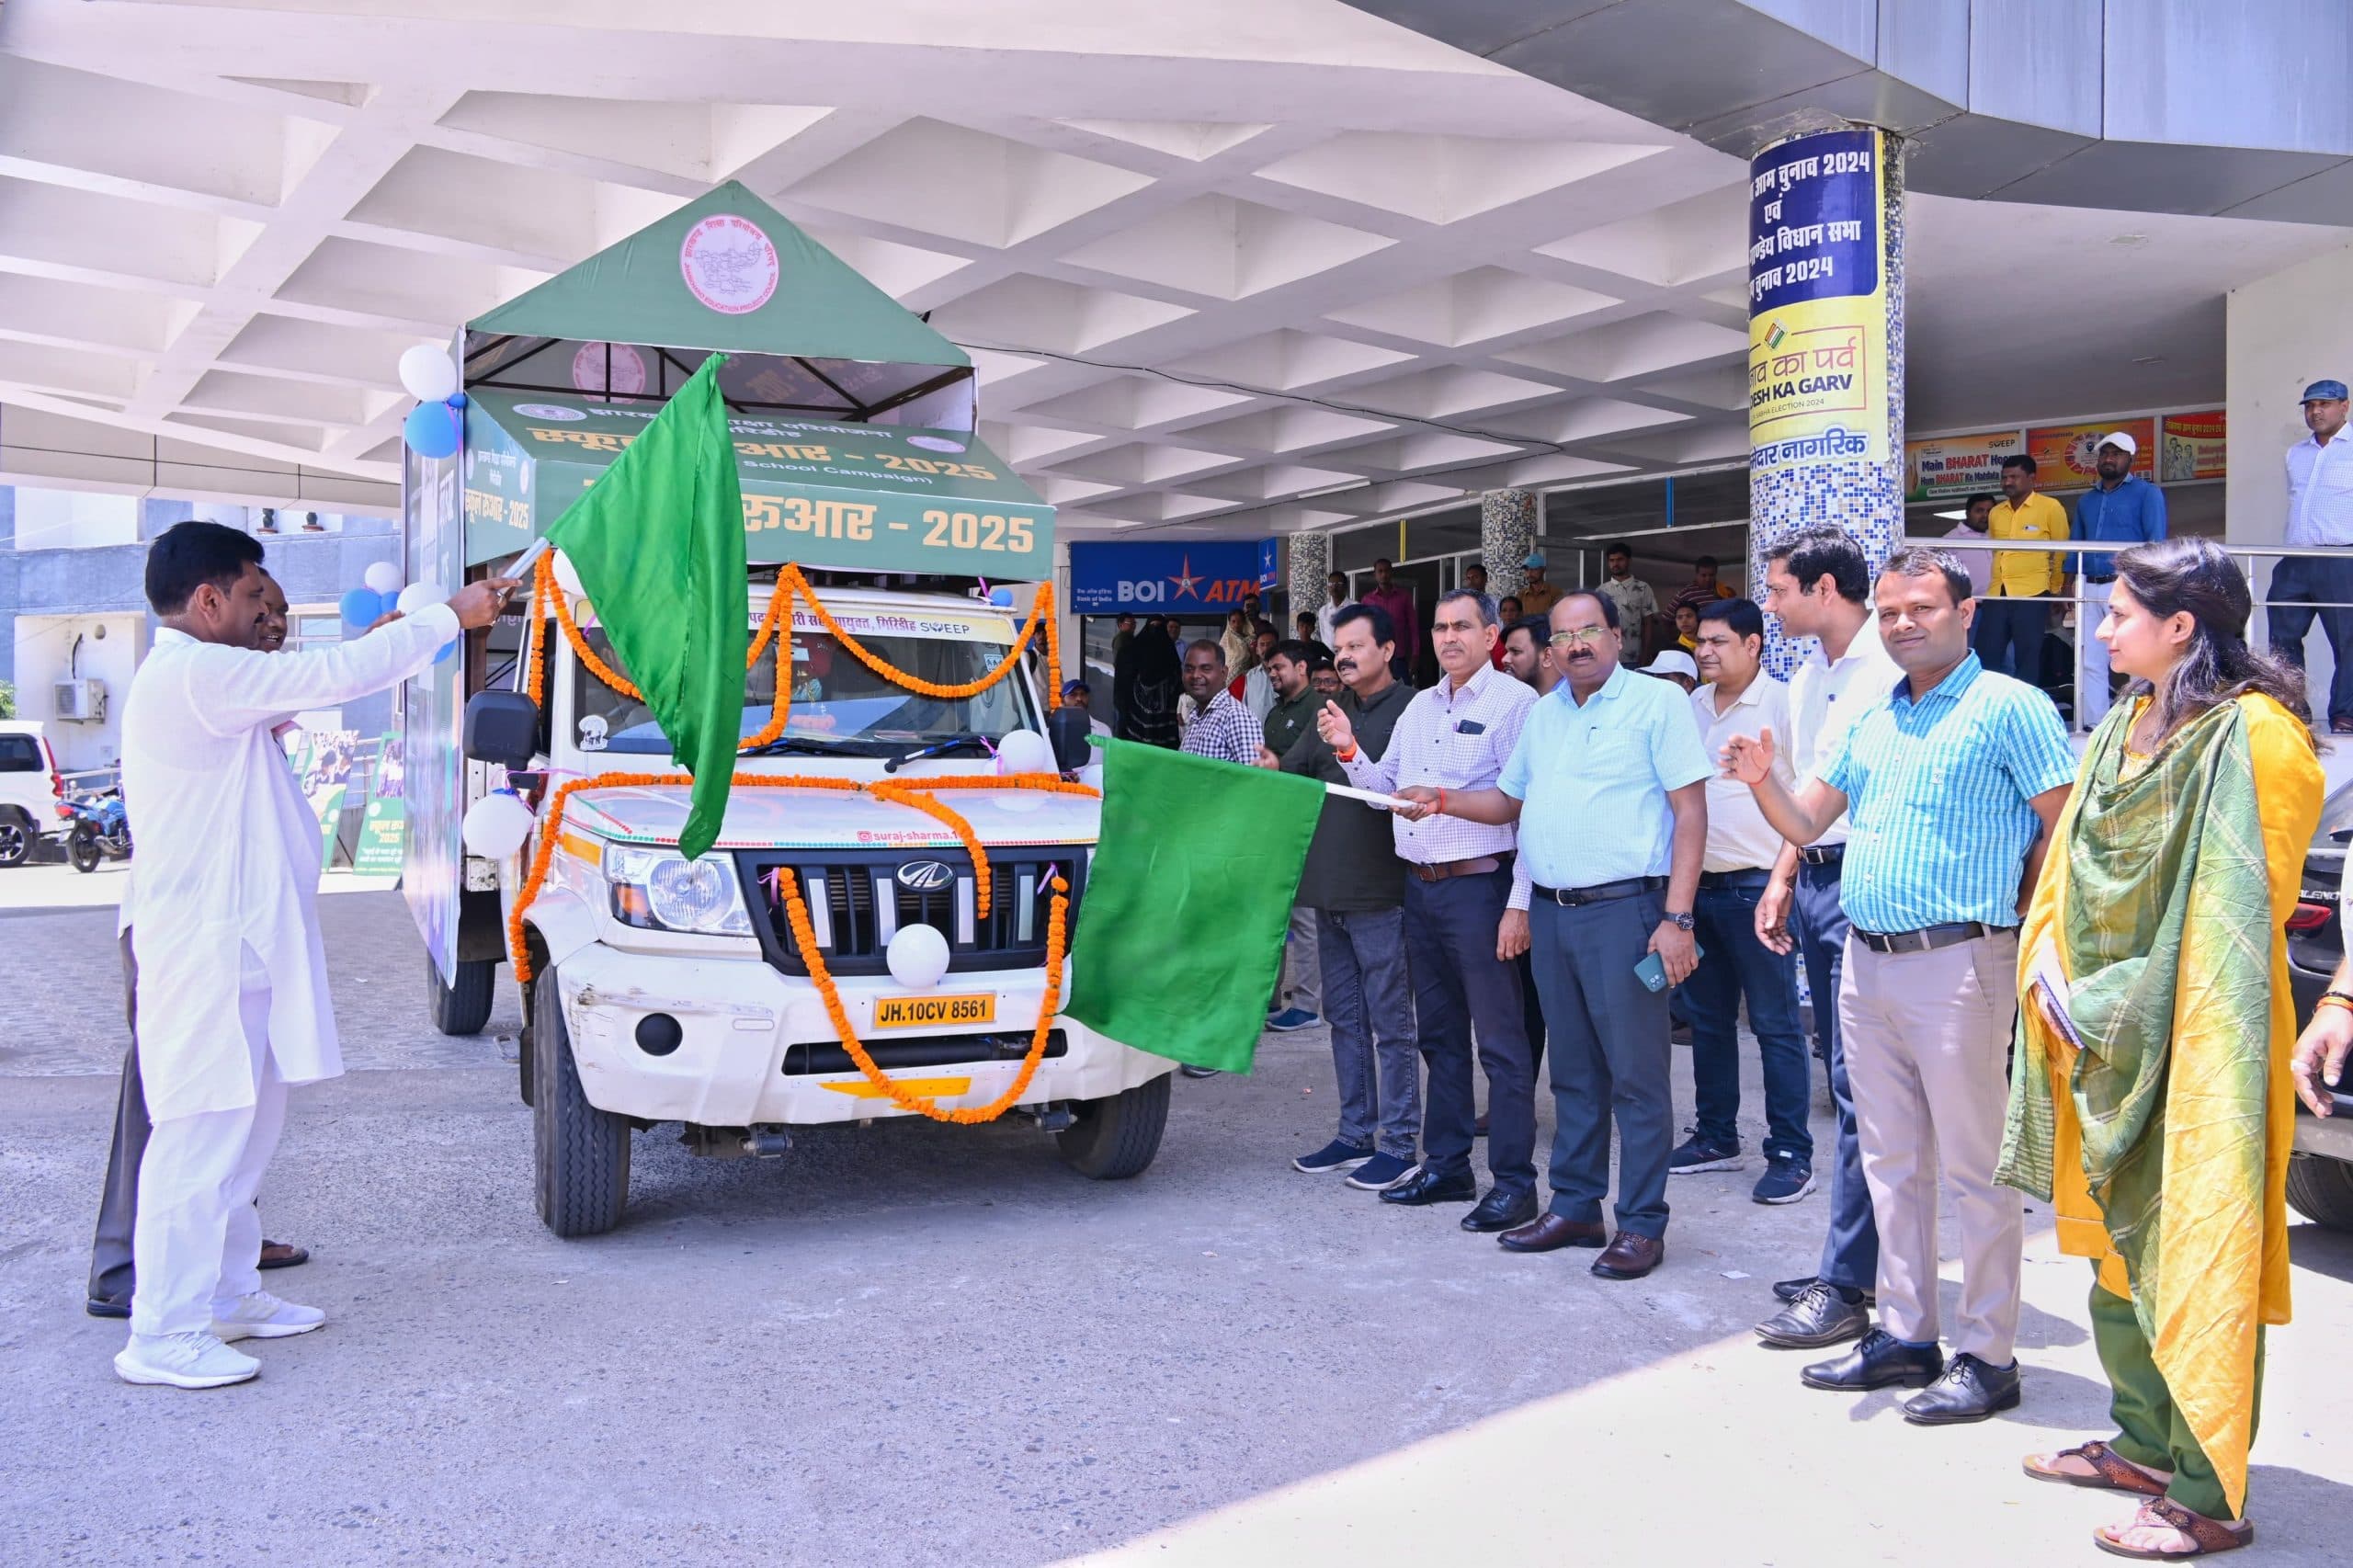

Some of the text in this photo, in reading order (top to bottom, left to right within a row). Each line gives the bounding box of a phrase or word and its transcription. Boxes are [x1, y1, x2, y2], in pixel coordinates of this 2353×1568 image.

[1756, 168, 1776, 197] आम
[1779, 156, 1819, 192] चुनाव
[1823, 152, 1870, 176] 2024
[1764, 192, 1783, 224] एवं
[1777, 223, 1824, 253] विधान
[1828, 221, 1862, 243] सभा
[1756, 267, 1783, 302] चुनाव
[1786, 256, 1834, 285] 2024
[1772, 351, 1808, 377] का
[1813, 336, 1857, 369] पर्व
[1772, 381, 1796, 400] KA
[1799, 374, 1853, 394] GARV
[1771, 401, 1804, 415] ELECTION
[1806, 398, 1824, 407] 2024
[1781, 427, 1867, 460] नागरिक
[1988, 439, 2016, 449] SWEEP
[743, 460, 933, 485] School Campaign)
[874, 454, 997, 481] 2025
[1921, 459, 1944, 472] Main
[1946, 454, 1990, 471] BHARAT
[1920, 476, 1935, 486] Hum
[1936, 472, 1964, 484] BHARAT
[509, 500, 529, 529] 2025
[889, 522, 909, 530] -
[923, 510, 1034, 553] 2025
[1118, 580, 1262, 603] BOI ATM
[920, 621, 971, 634] SWEEP
[881, 999, 987, 1022] JH.10CV 8561
